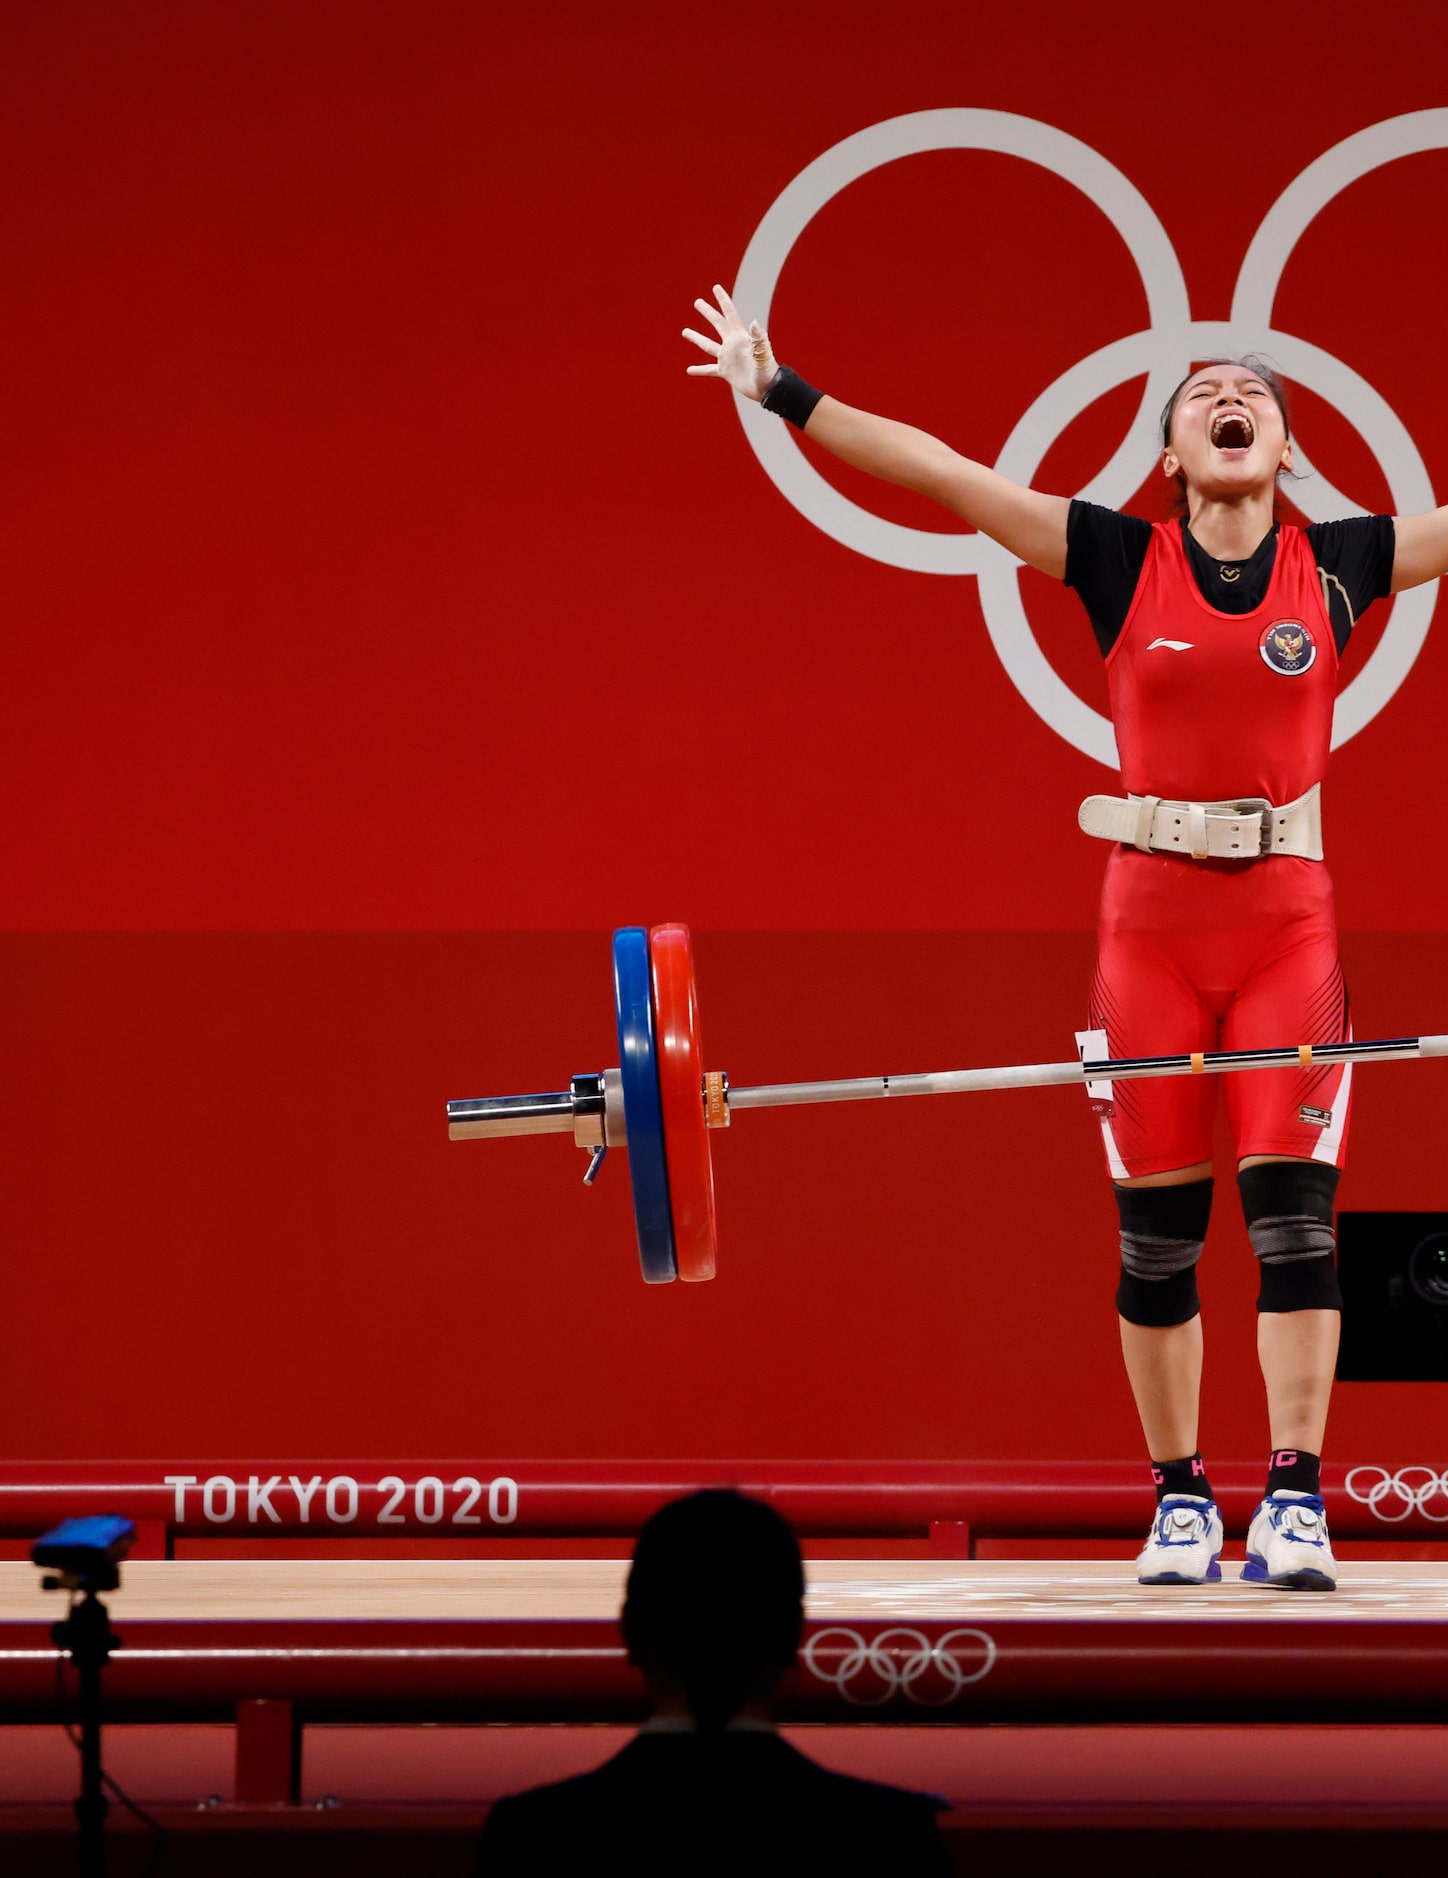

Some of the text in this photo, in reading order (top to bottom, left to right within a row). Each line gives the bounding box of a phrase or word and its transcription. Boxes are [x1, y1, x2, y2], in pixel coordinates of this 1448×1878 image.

[710, 1085, 721, 1113] TOKYO
[164, 1475, 519, 1525] TOKYO 2020
